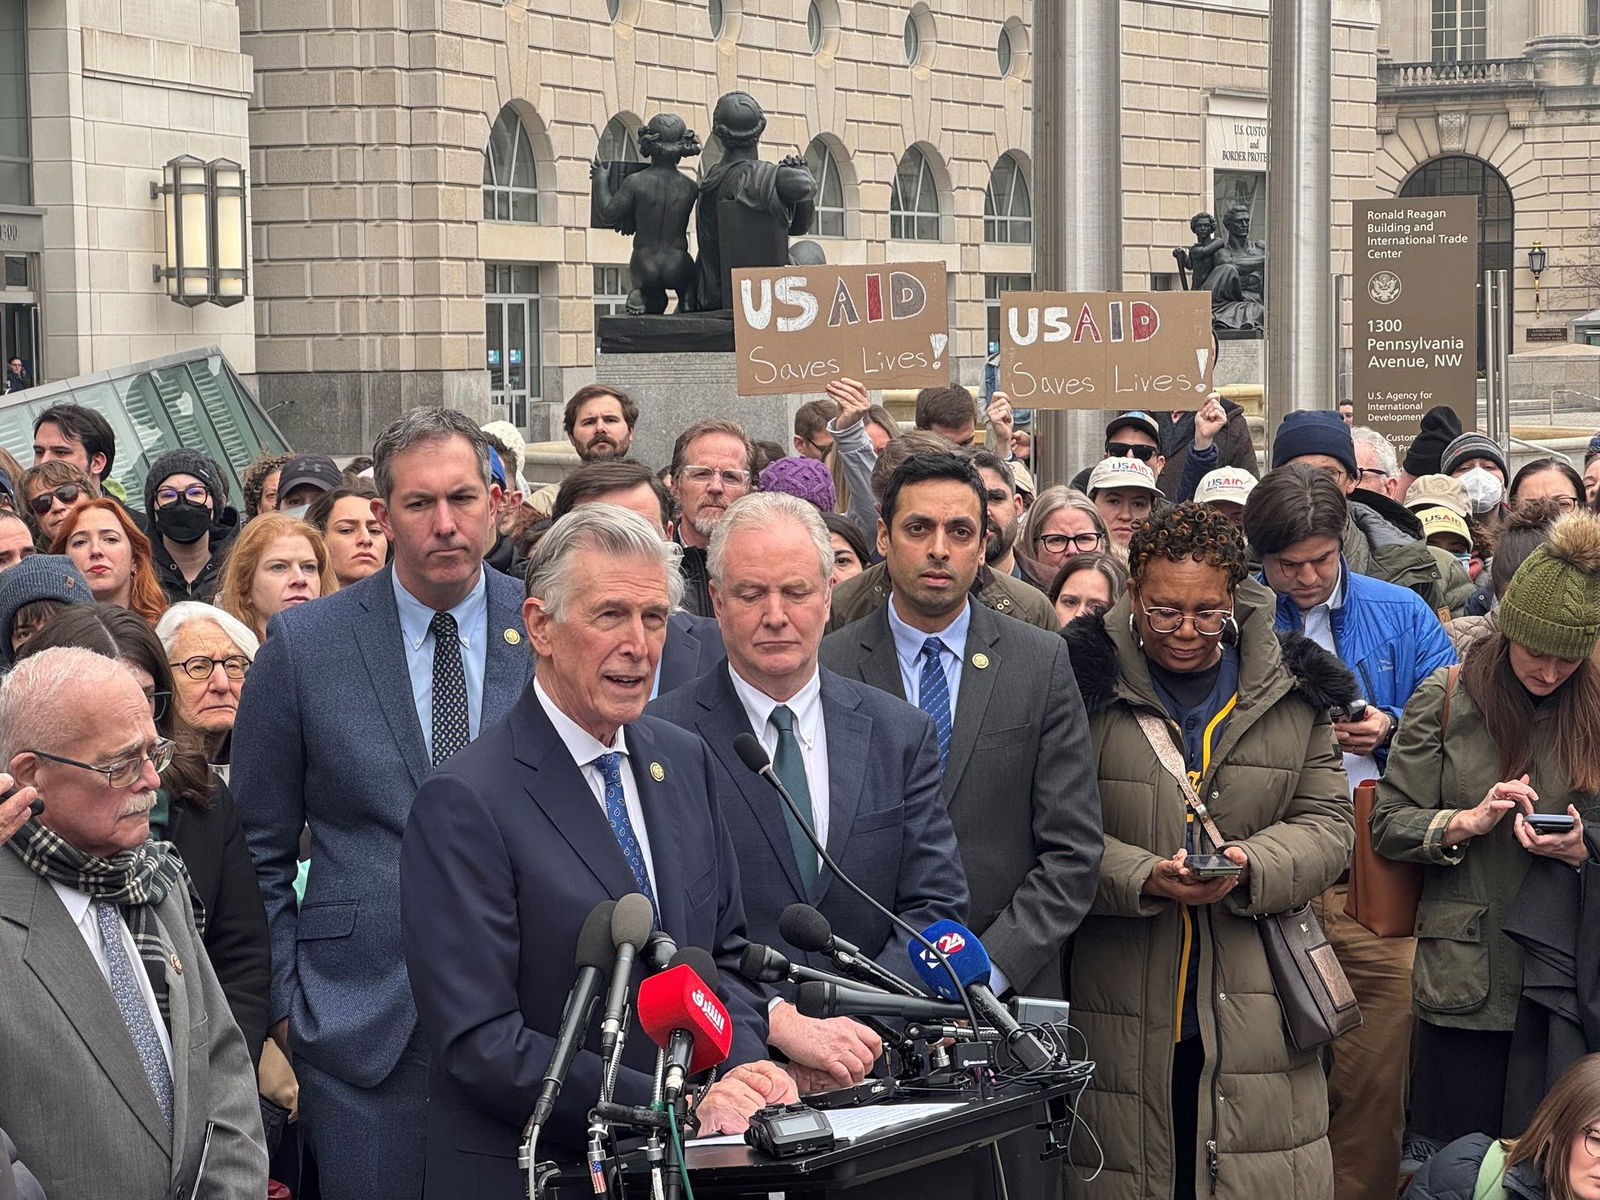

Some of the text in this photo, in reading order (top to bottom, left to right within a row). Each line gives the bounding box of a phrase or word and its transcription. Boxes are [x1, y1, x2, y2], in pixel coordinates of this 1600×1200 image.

[1246, 126, 1266, 136] CUSTO
[1250, 139, 1259, 149] and
[1222, 150, 1268, 162] BORDER PROTE
[1367, 209, 1446, 220] Ronald Reagan
[1367, 221, 1434, 234] Building and
[1367, 233, 1468, 246] International Trade
[1367, 249, 1402, 259] Center
[741, 271, 927, 332] USAID
[1008, 301, 1161, 346] USAID
[1367, 319, 1402, 332] 1300
[1367, 336, 1464, 353] Pennsylvania
[750, 333, 948, 384] Saves Lives!
[1368, 354, 1462, 369] Avenue, NW
[1011, 348, 1209, 397] Saves Lives!
[1367, 390, 1433, 401] U.S. Agency for
[1367, 402, 1423, 410] International
[1367, 413, 1424, 422] Development
[1112, 462, 1148, 475] USAID
[1207, 478, 1243, 488] USAID
[1425, 514, 1462, 527] USAID
[692, 989, 725, 1034] الشرق
